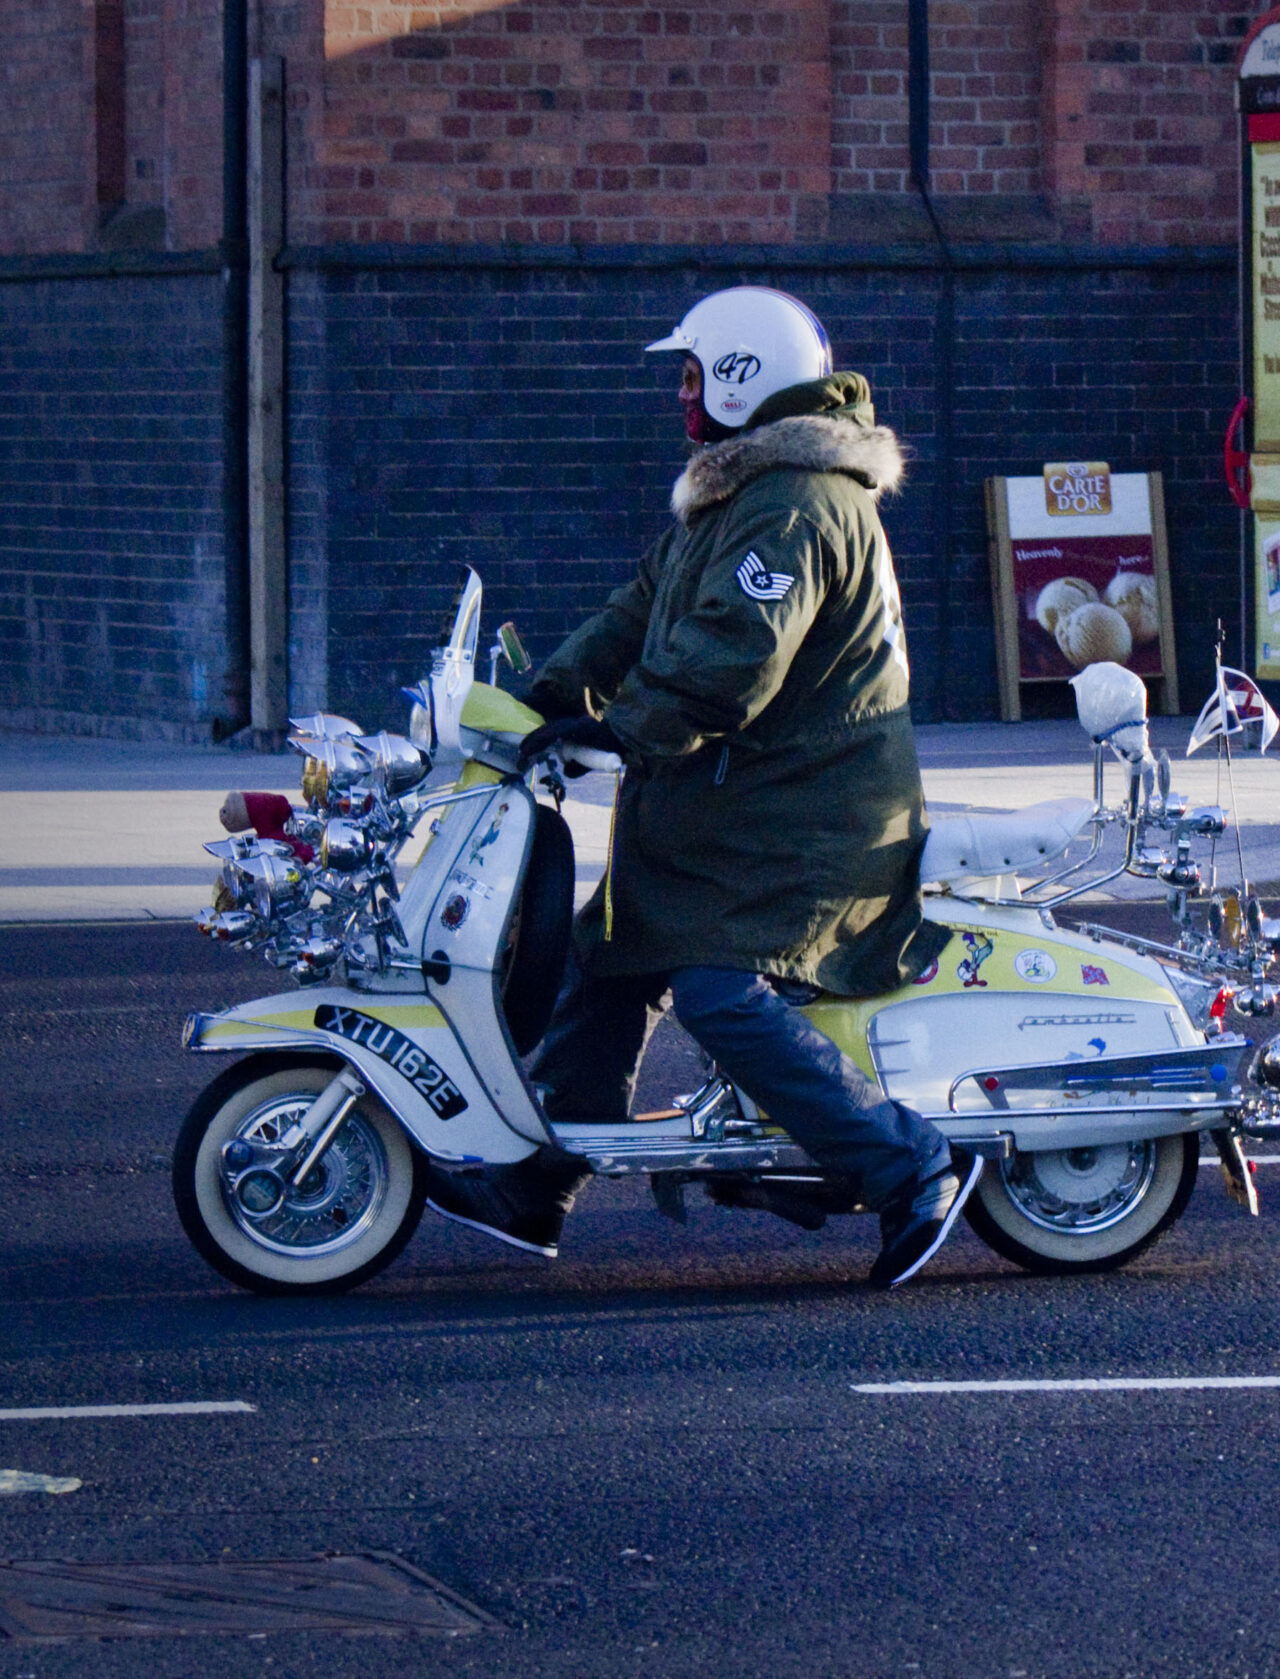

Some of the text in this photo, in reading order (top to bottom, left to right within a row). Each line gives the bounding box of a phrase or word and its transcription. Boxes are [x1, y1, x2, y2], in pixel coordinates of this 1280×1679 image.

[717, 351, 753, 385] 47
[1048, 475, 1106, 495] CARTE
[1056, 493, 1103, 513] D'OR
[1015, 547, 1063, 562] Heavenly
